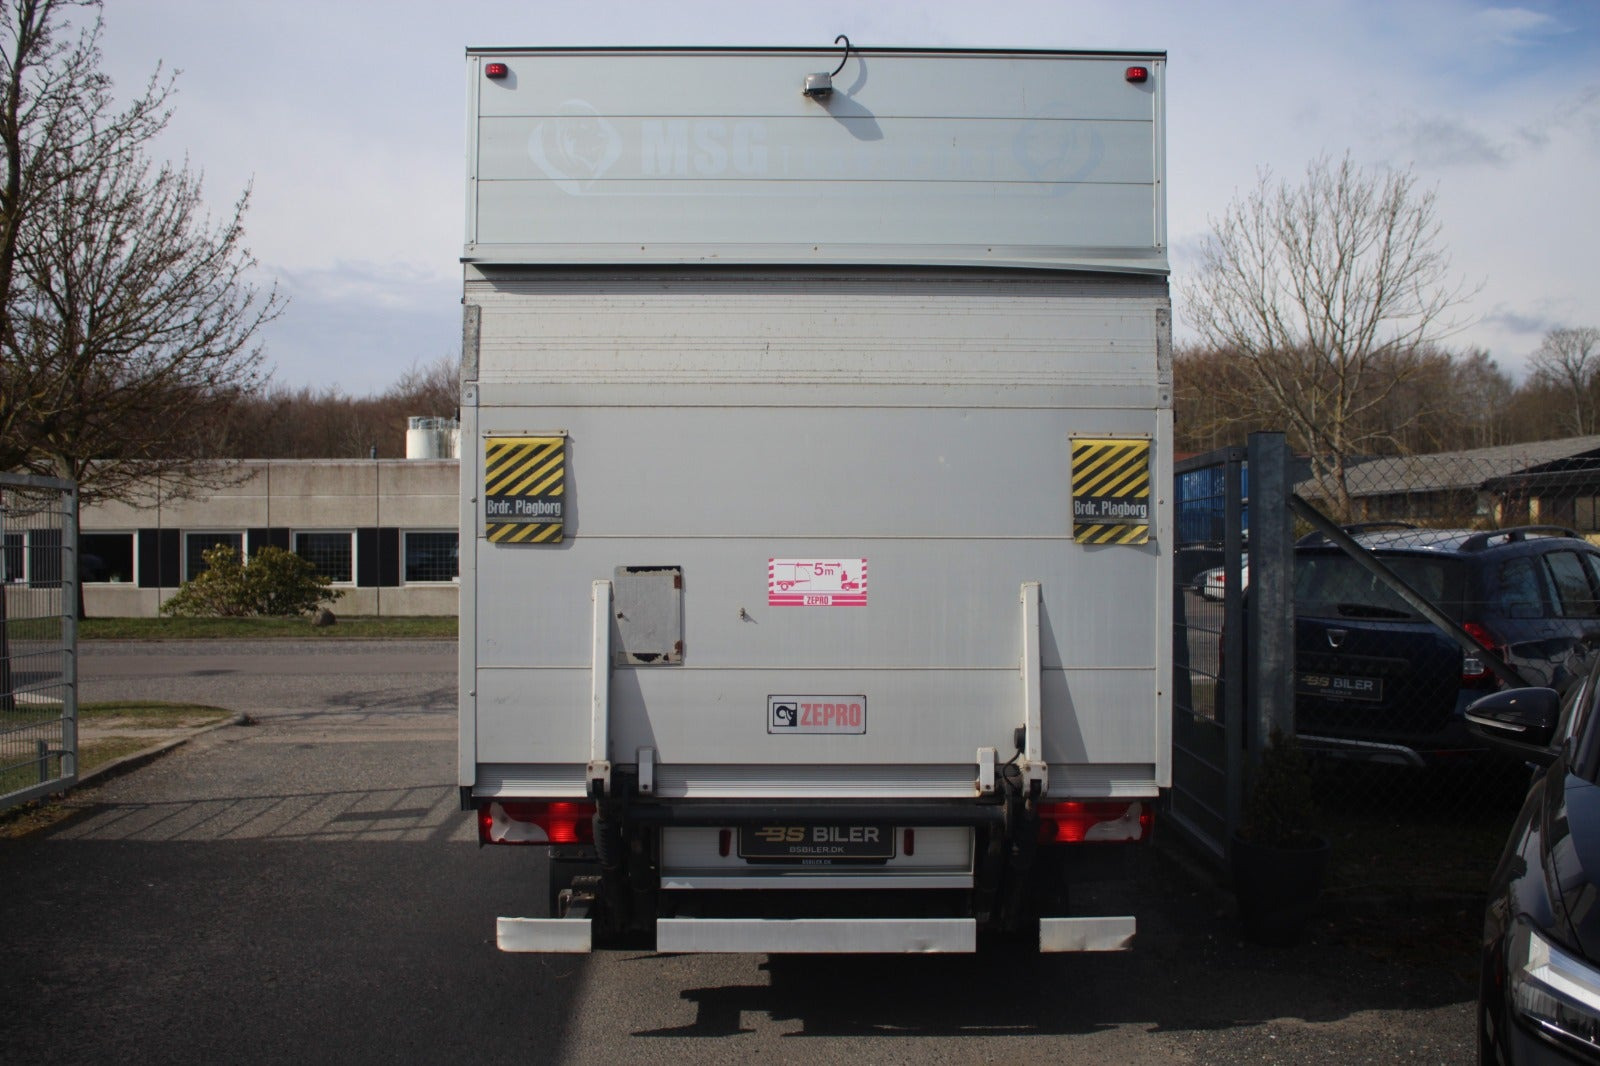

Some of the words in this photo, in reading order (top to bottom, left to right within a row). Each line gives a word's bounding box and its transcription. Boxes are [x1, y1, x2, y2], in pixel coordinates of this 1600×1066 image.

[640, 119, 768, 176] MSG
[487, 499, 512, 514] Brdr.
[515, 499, 561, 516] Plagborg
[1074, 501, 1099, 515] Brdr.
[1102, 501, 1147, 518] Plagborg
[806, 596, 829, 605] ZEPRO
[1333, 677, 1374, 691] BILER
[800, 703, 862, 727] ZEPRO
[812, 826, 880, 843] BILER
[789, 846, 844, 854] BSBILER.DK
